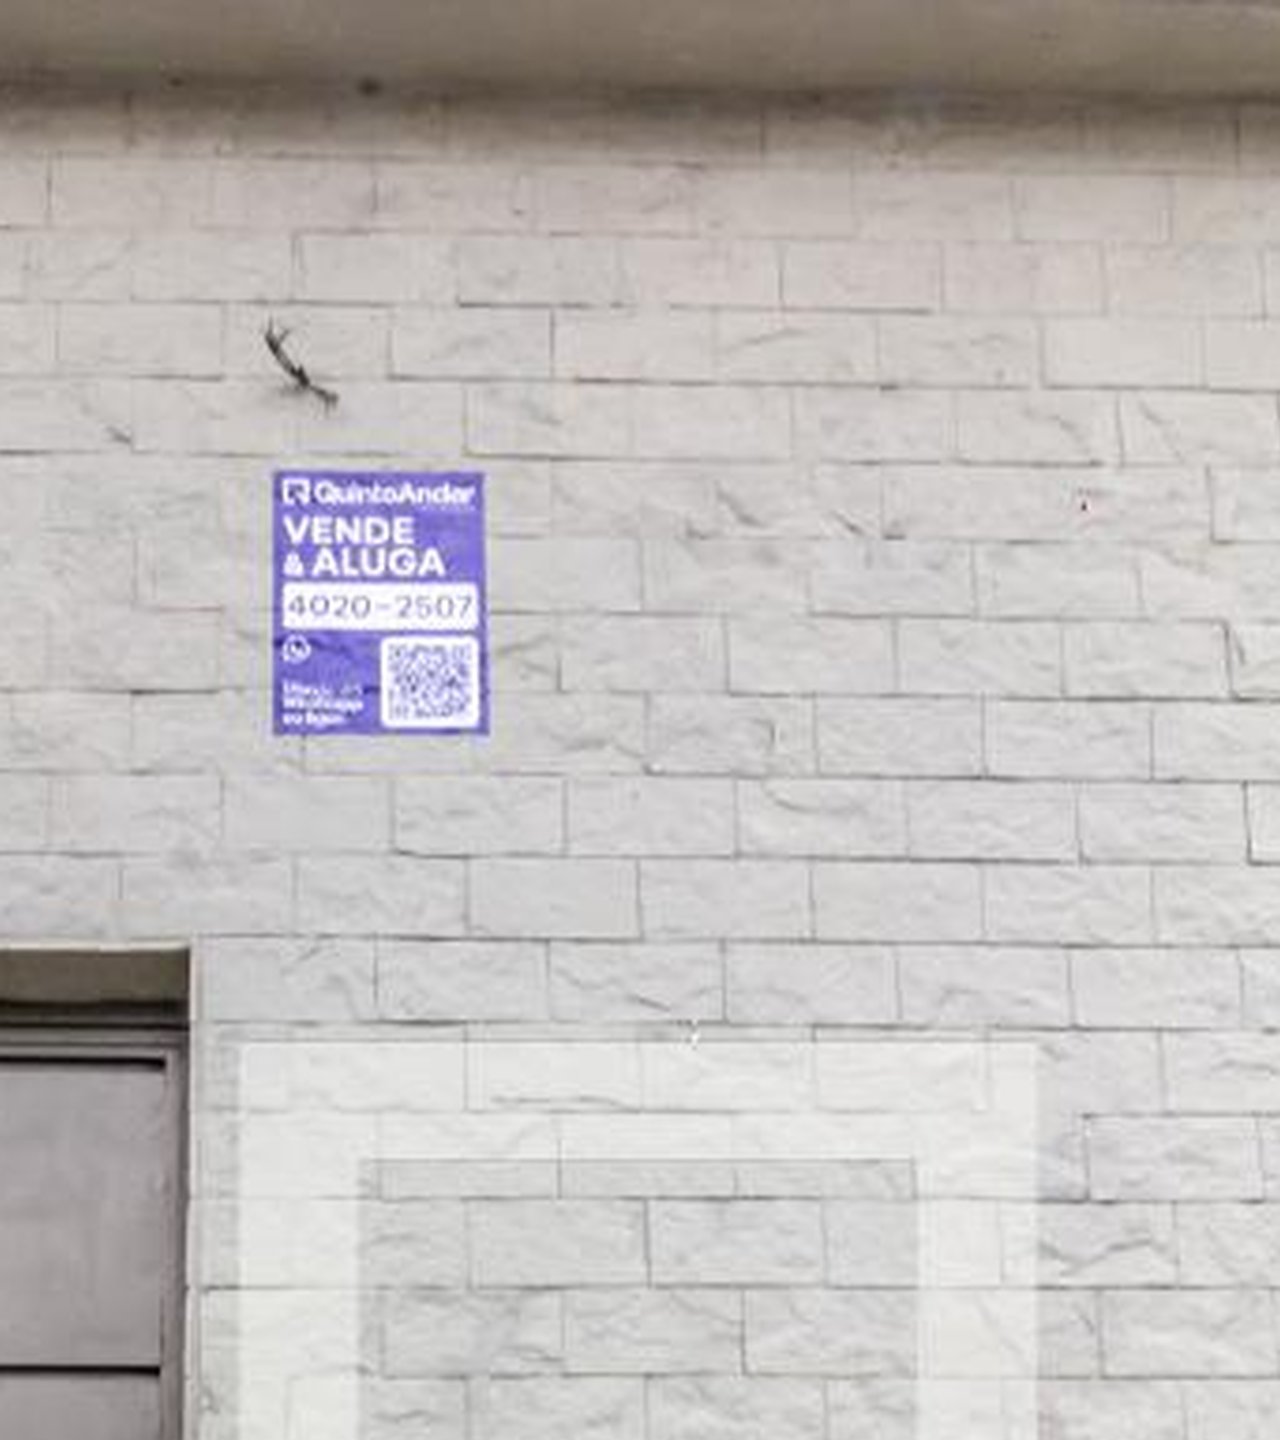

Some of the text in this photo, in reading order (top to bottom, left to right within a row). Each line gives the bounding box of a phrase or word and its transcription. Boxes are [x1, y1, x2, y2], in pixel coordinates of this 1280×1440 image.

[314, 480, 476, 504] QuintoAndar
[282, 515, 415, 545] VENDE
[311, 547, 446, 577] ALUGA
[287, 594, 473, 619] 4020-2507
